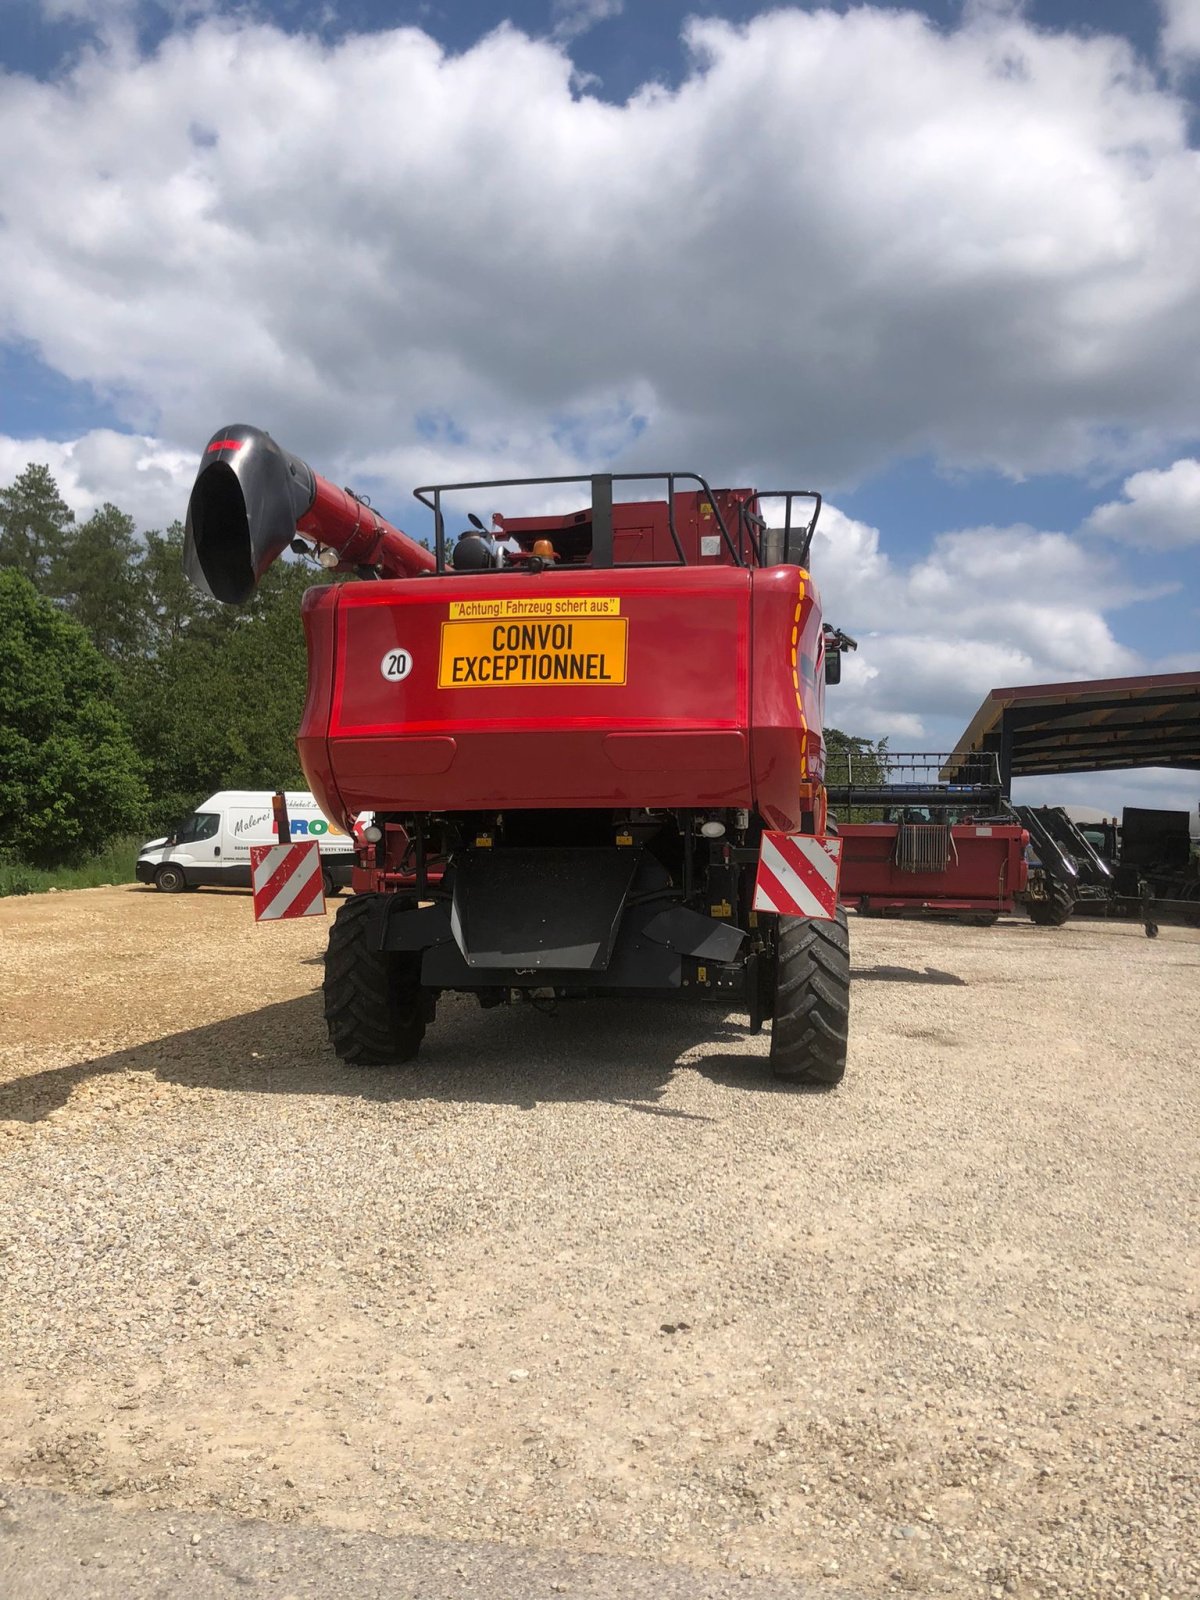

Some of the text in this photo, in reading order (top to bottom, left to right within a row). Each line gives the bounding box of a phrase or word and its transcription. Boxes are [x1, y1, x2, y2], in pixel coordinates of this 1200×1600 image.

[454, 603, 503, 617] "Achtung!
[506, 600, 552, 614] Fahrzeug
[555, 599, 588, 613] schert
[492, 624, 573, 651] CONVOI
[387, 654, 406, 675] 20
[452, 654, 611, 682] EXCEPTIONNEL
[234, 809, 271, 836] Malerei
